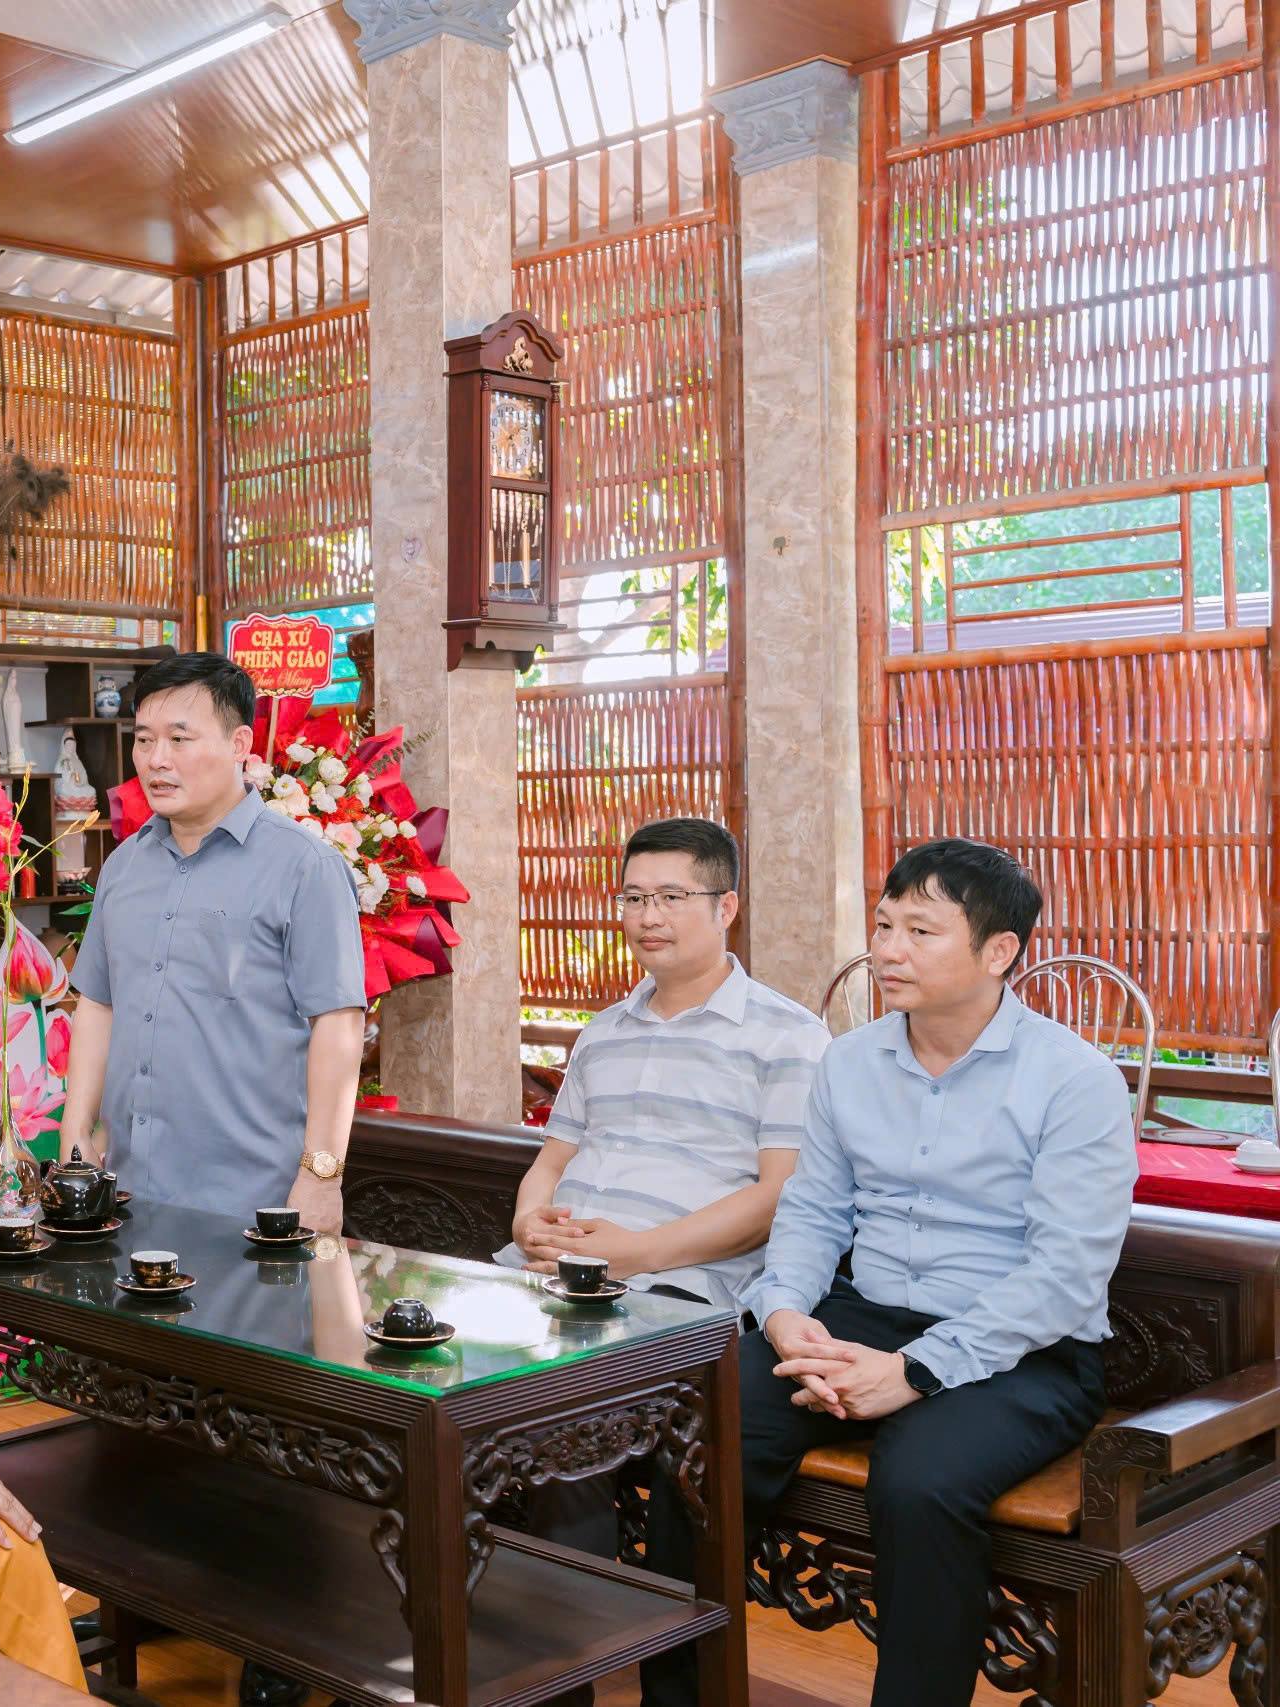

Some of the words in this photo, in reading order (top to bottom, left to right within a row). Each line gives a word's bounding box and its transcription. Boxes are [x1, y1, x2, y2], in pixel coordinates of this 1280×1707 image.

[251, 630, 283, 646] CHA
[287, 626, 313, 647] XỨ
[234, 647, 282, 672] THIỆN
[287, 646, 327, 669] GIÁO
